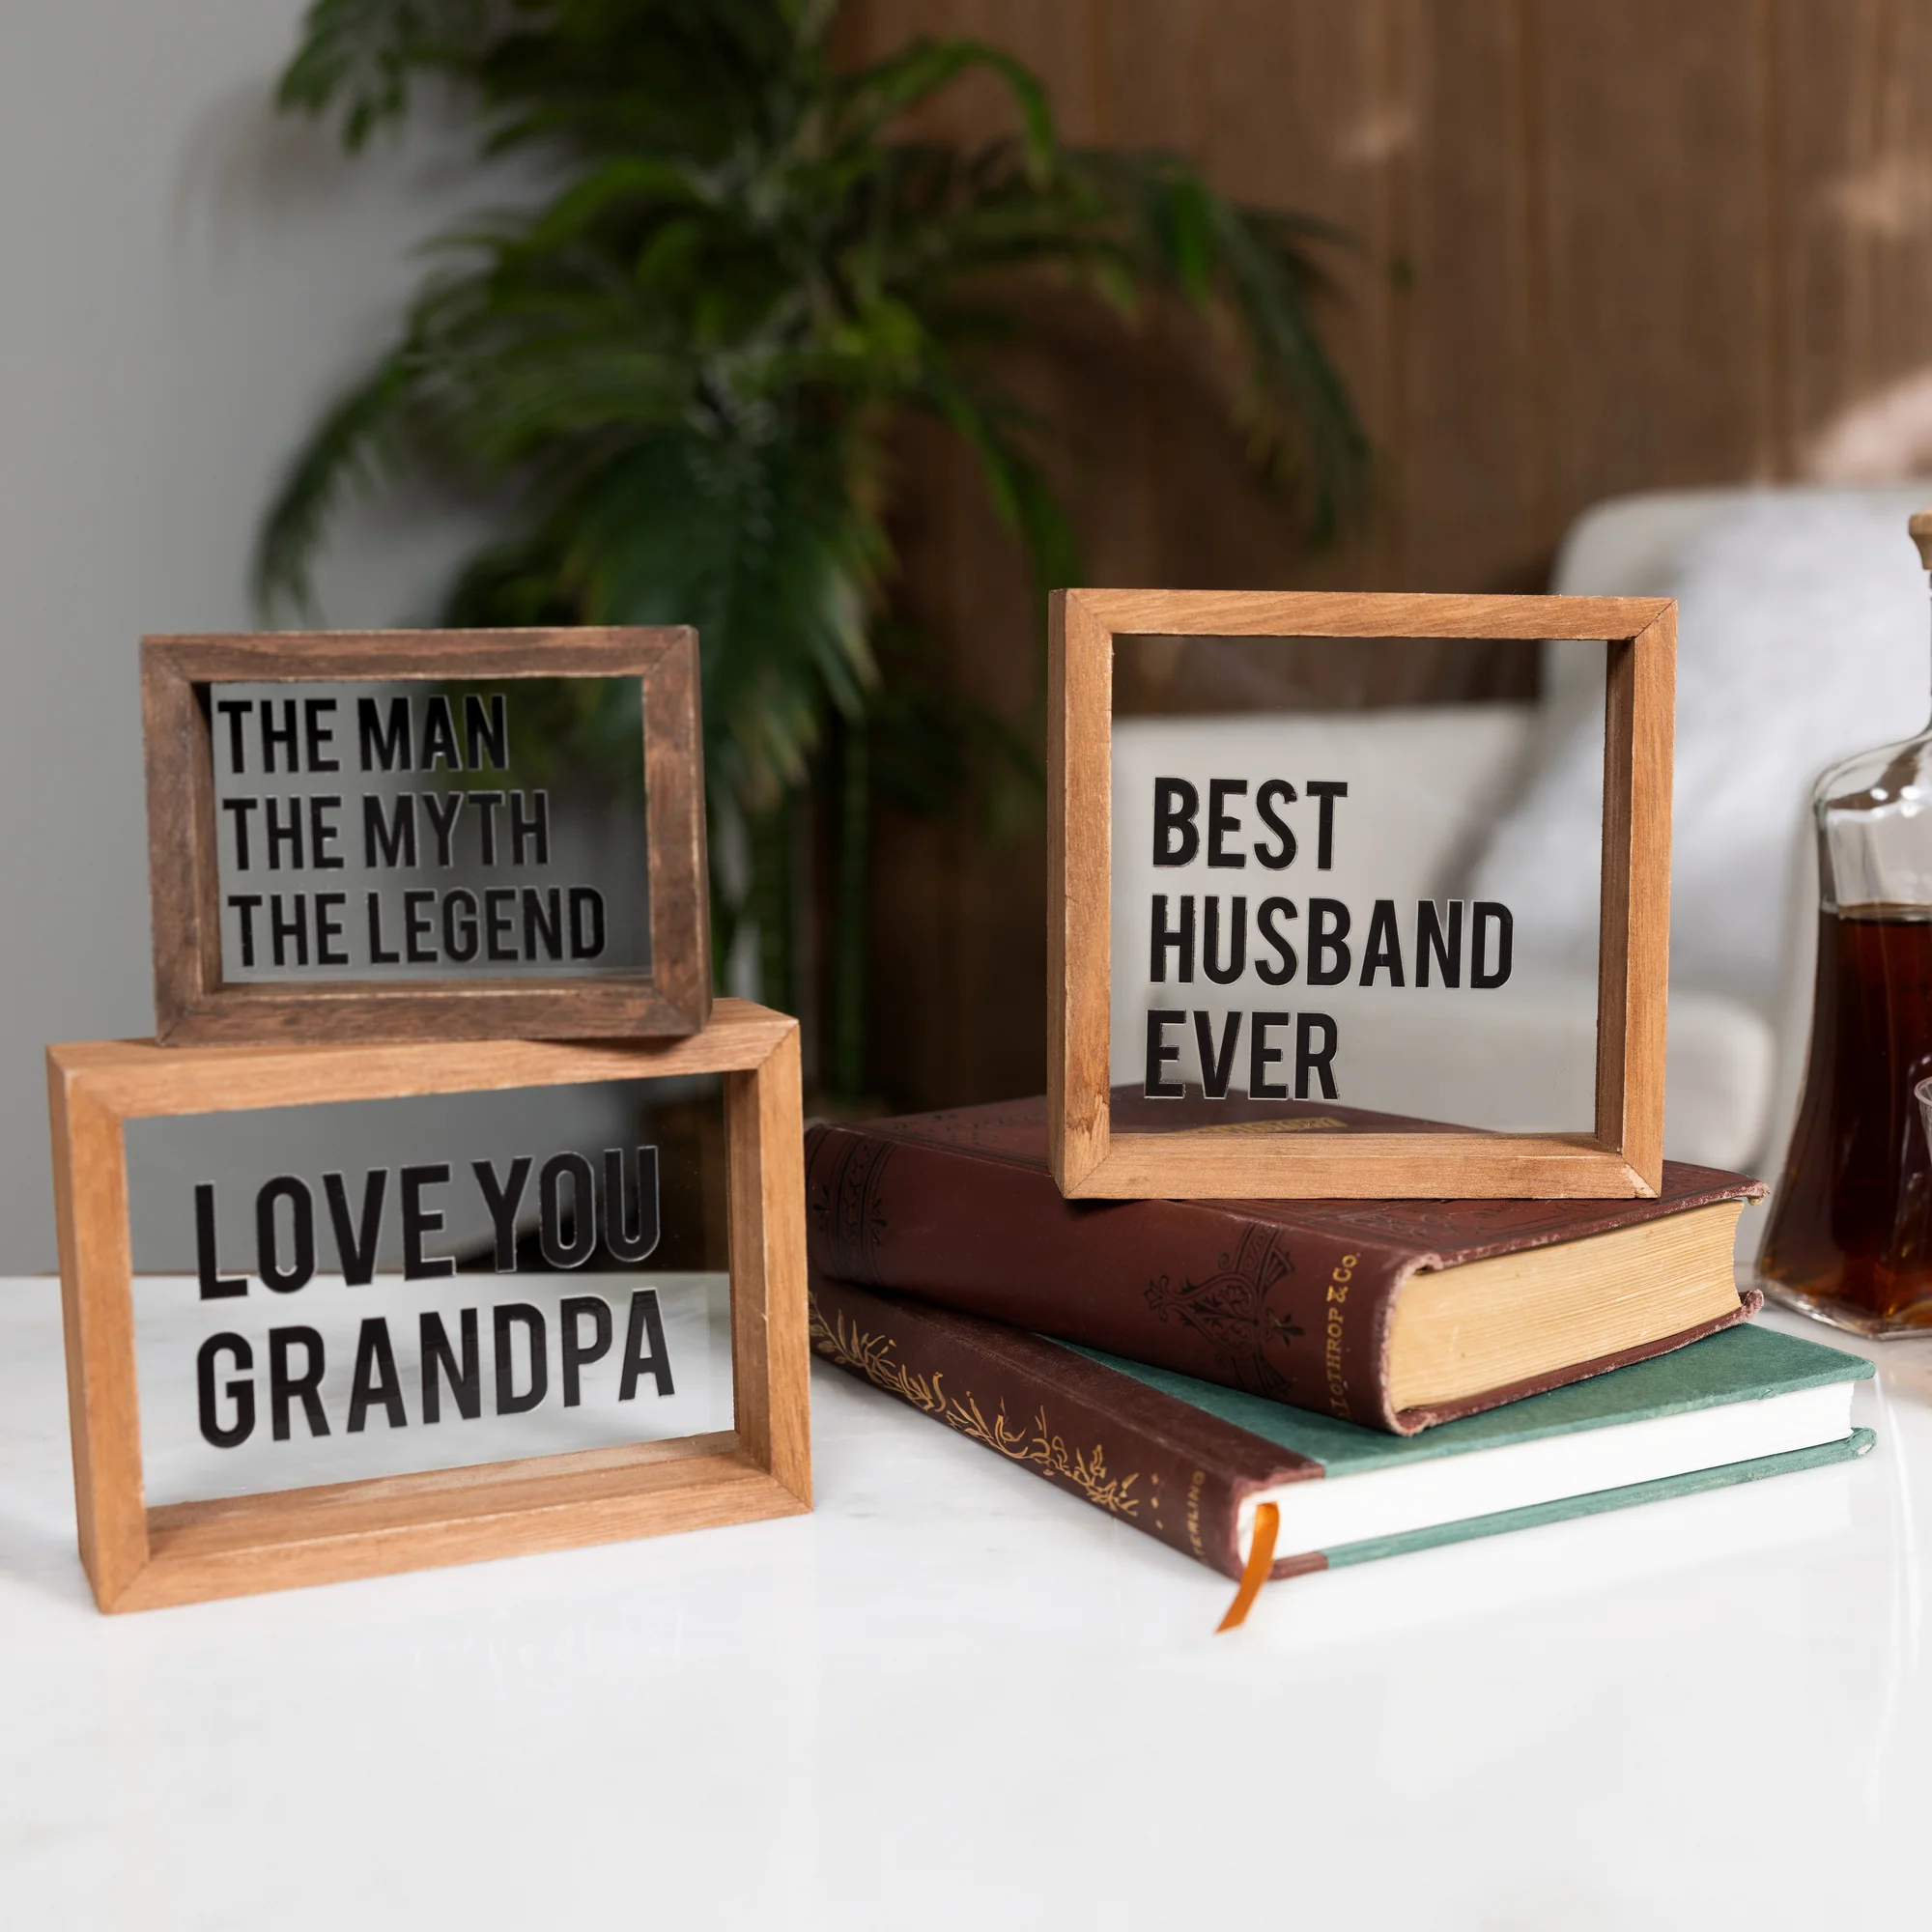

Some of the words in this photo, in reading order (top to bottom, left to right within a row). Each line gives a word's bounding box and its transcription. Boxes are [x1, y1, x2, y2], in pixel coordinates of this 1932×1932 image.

[217, 698, 340, 774] THE
[356, 694, 509, 773] MAN
[223, 796, 345, 870] THE
[362, 789, 549, 869] MYTH
[1152, 777, 1350, 870] BEST
[228, 892, 349, 967] THE
[367, 887, 607, 965] LEGEND
[1149, 895, 1515, 990] HUSBAND
[1144, 1009, 1341, 1100] EVER
[194, 1162, 457, 1300] LOVE
[471, 1145, 661, 1273] YOU
[1326, 1284, 1349, 1303] &
[196, 1289, 676, 1449] GRANDPA
[1326, 1307, 1350, 1412] LOTHROP
